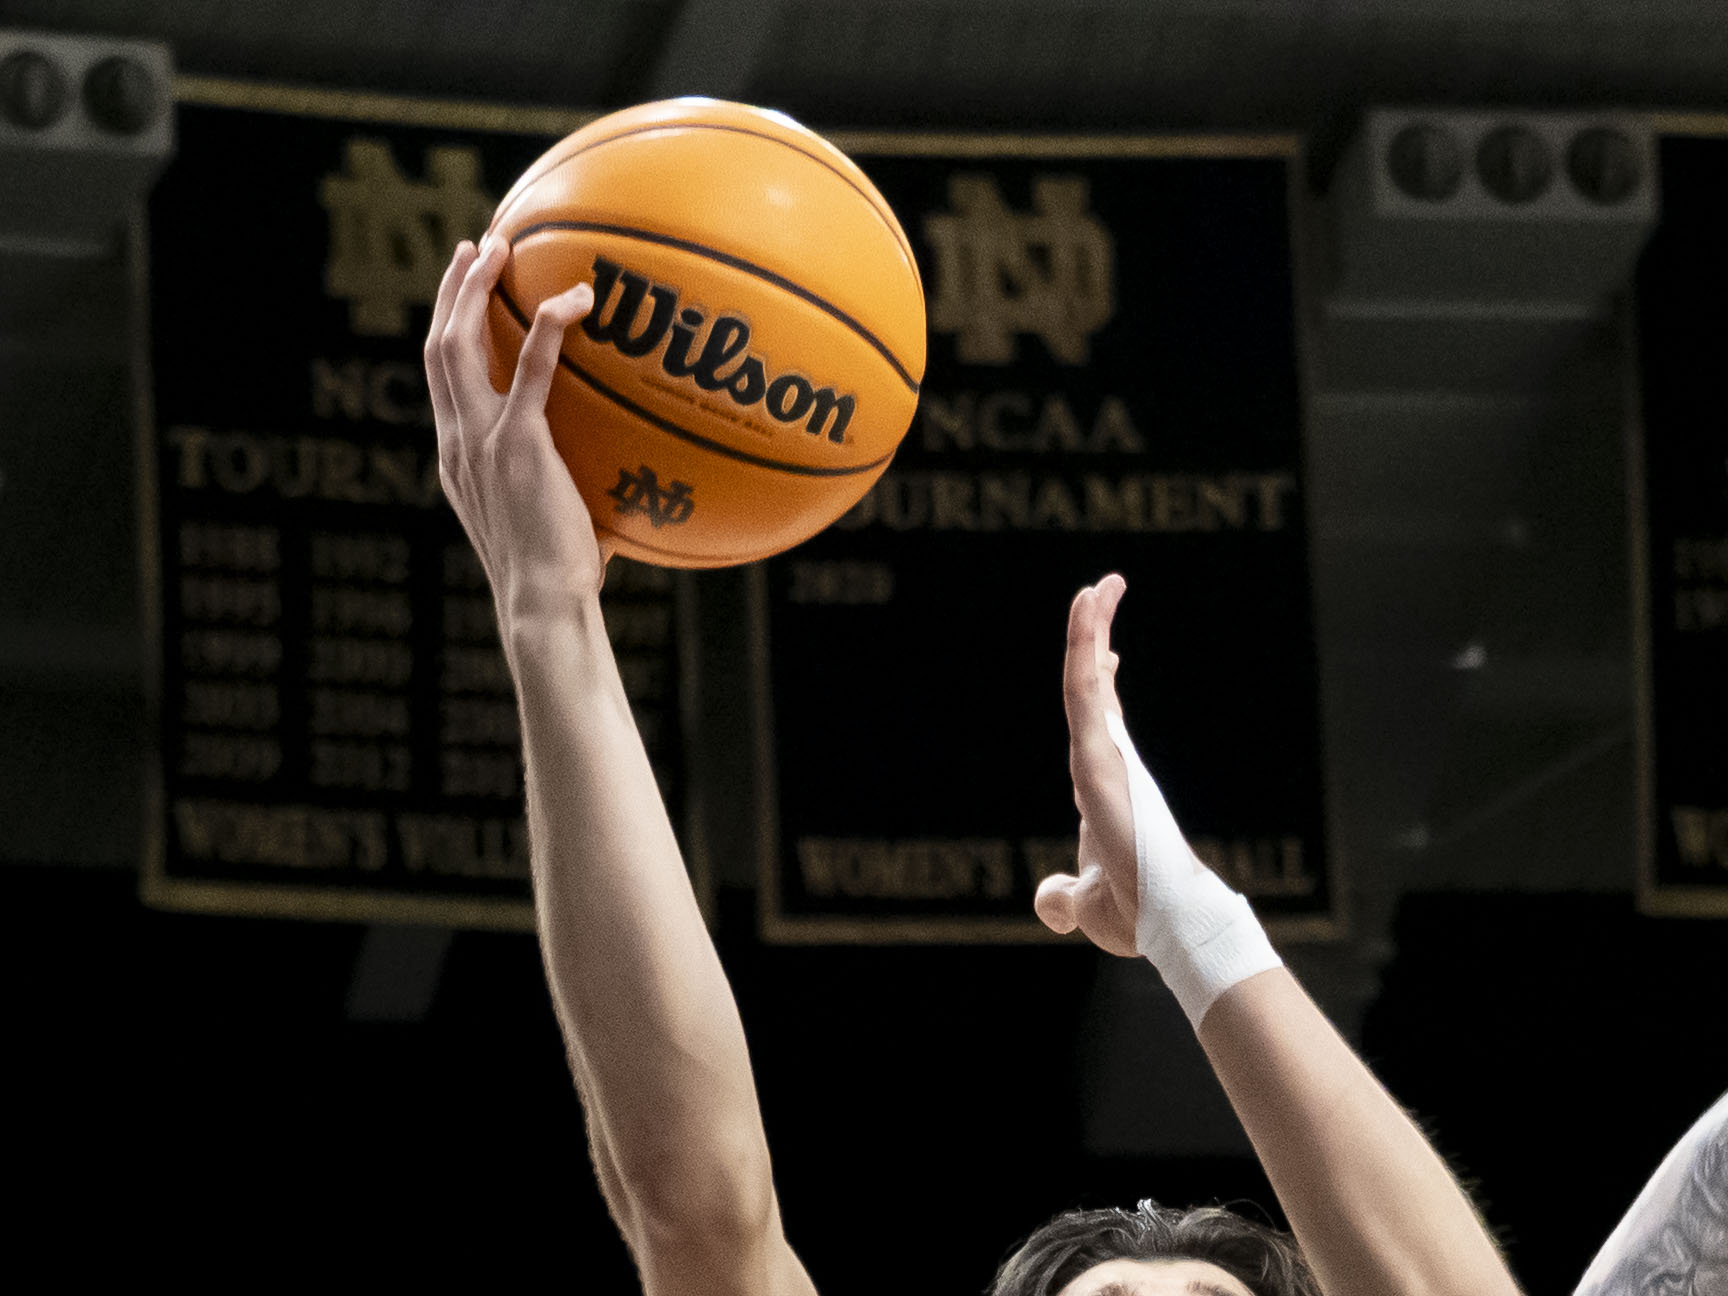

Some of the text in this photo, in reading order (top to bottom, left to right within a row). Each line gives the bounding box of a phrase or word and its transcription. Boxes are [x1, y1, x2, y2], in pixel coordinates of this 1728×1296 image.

[581, 254, 857, 444] Wilson
[312, 359, 427, 423] NC
[924, 393, 1145, 453] NCAA
